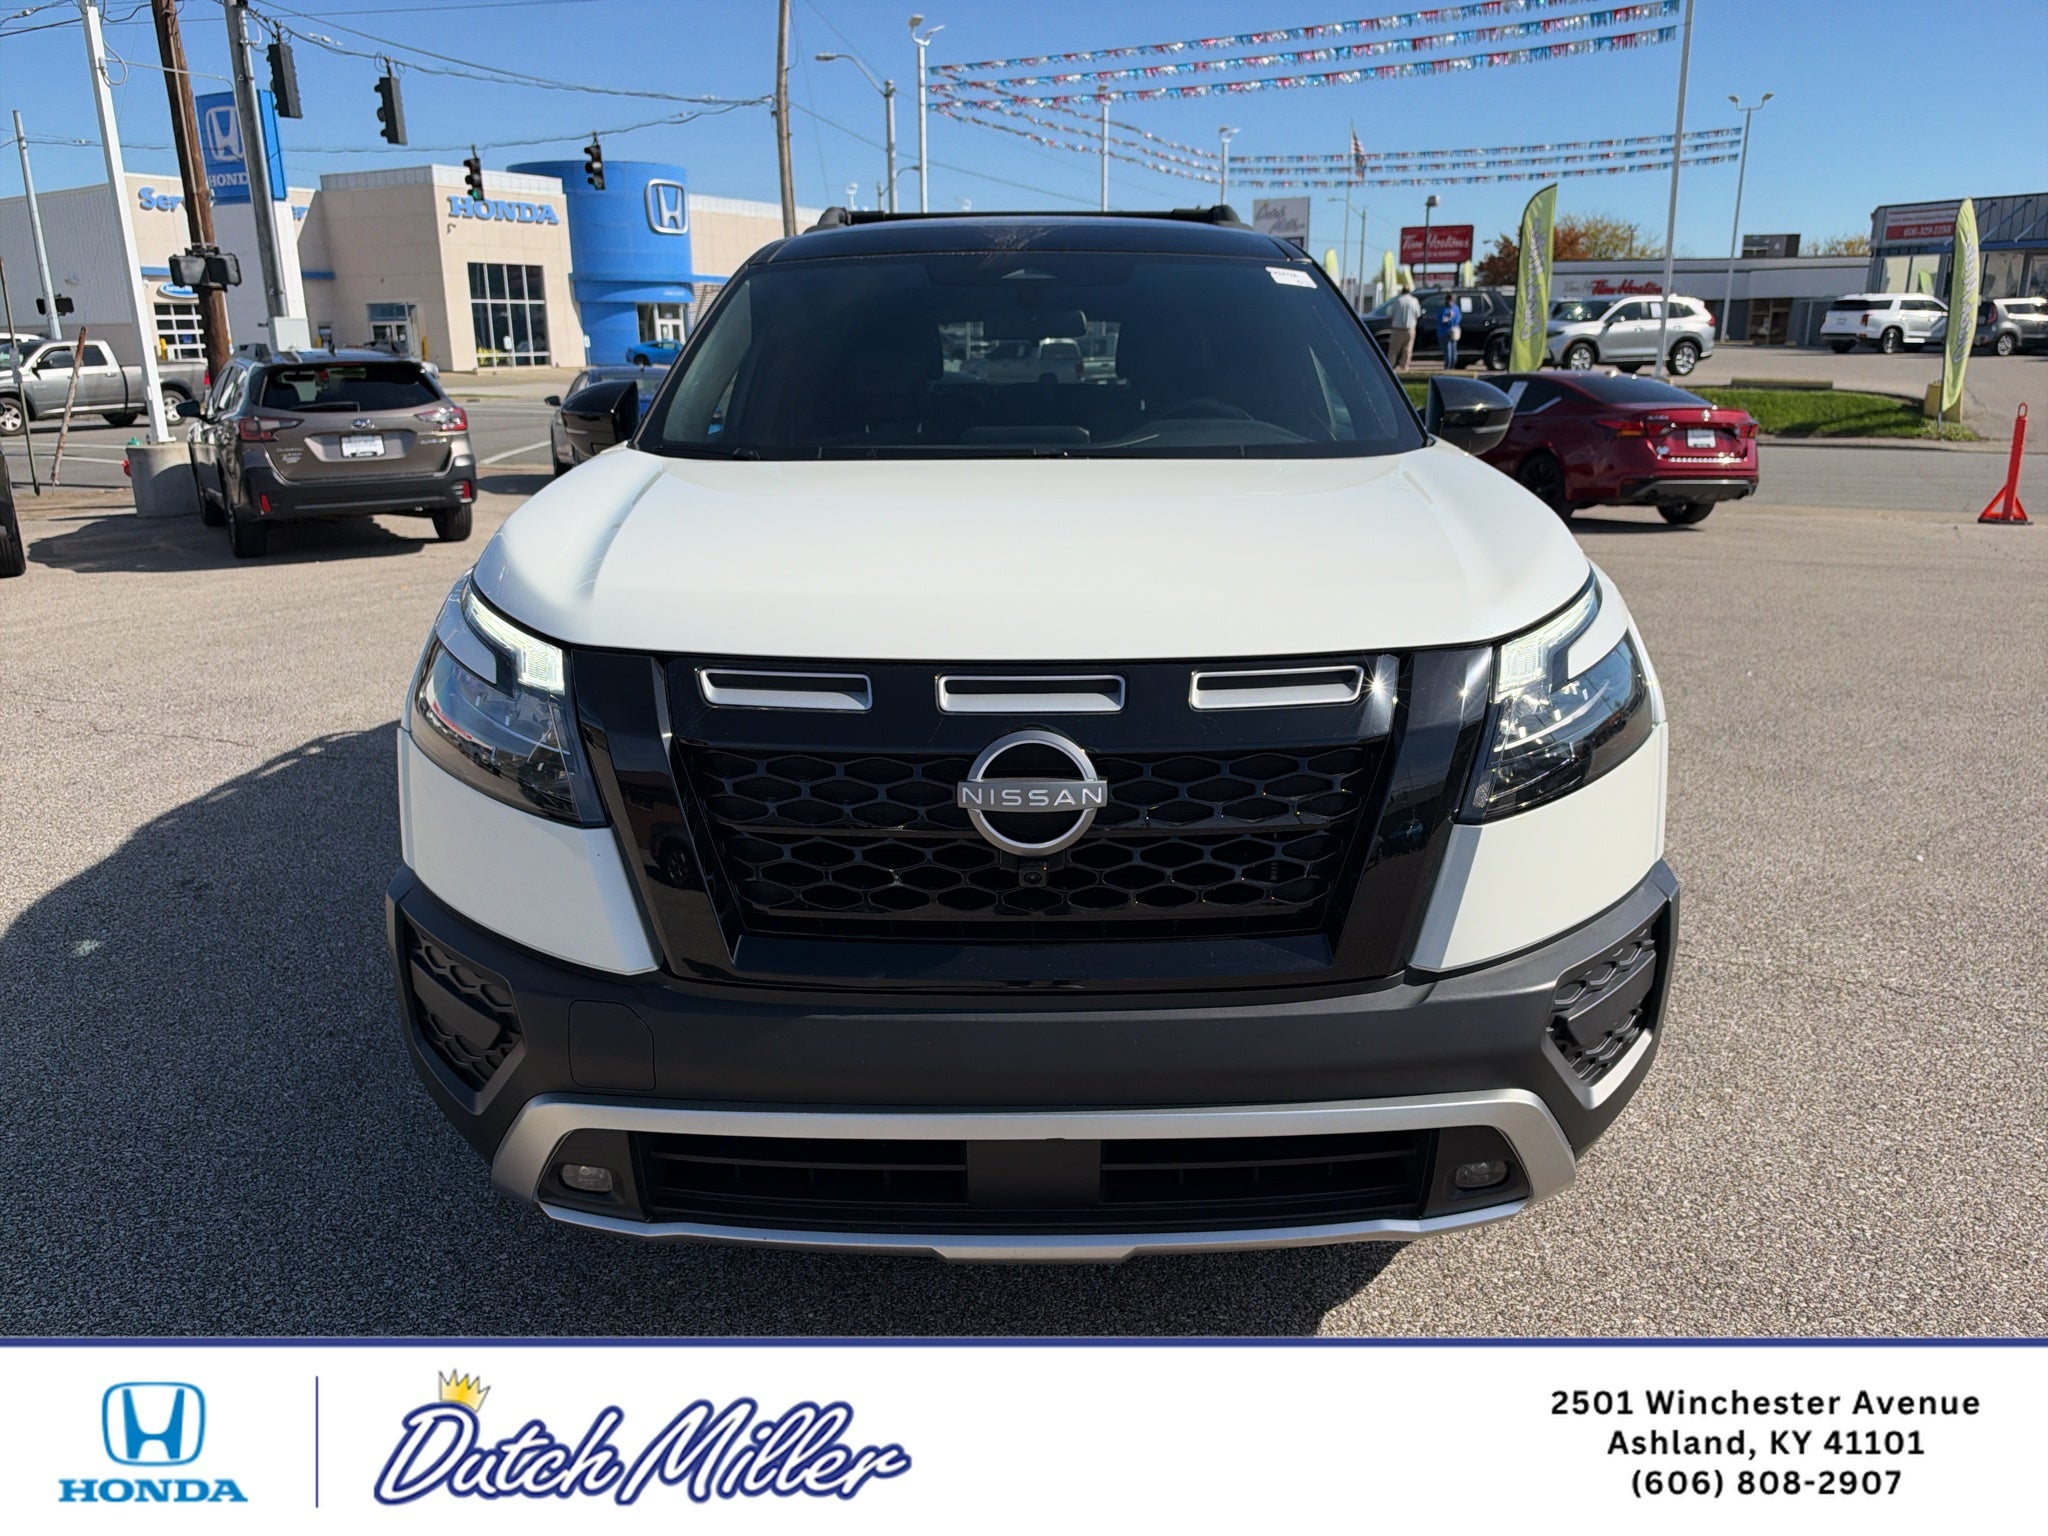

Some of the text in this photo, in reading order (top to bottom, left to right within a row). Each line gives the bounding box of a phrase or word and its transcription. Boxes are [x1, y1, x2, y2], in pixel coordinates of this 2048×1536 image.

[447, 196, 559, 225] HONDA
[1592, 278, 1617, 295] Tim
[961, 787, 1102, 807] NISSAN
